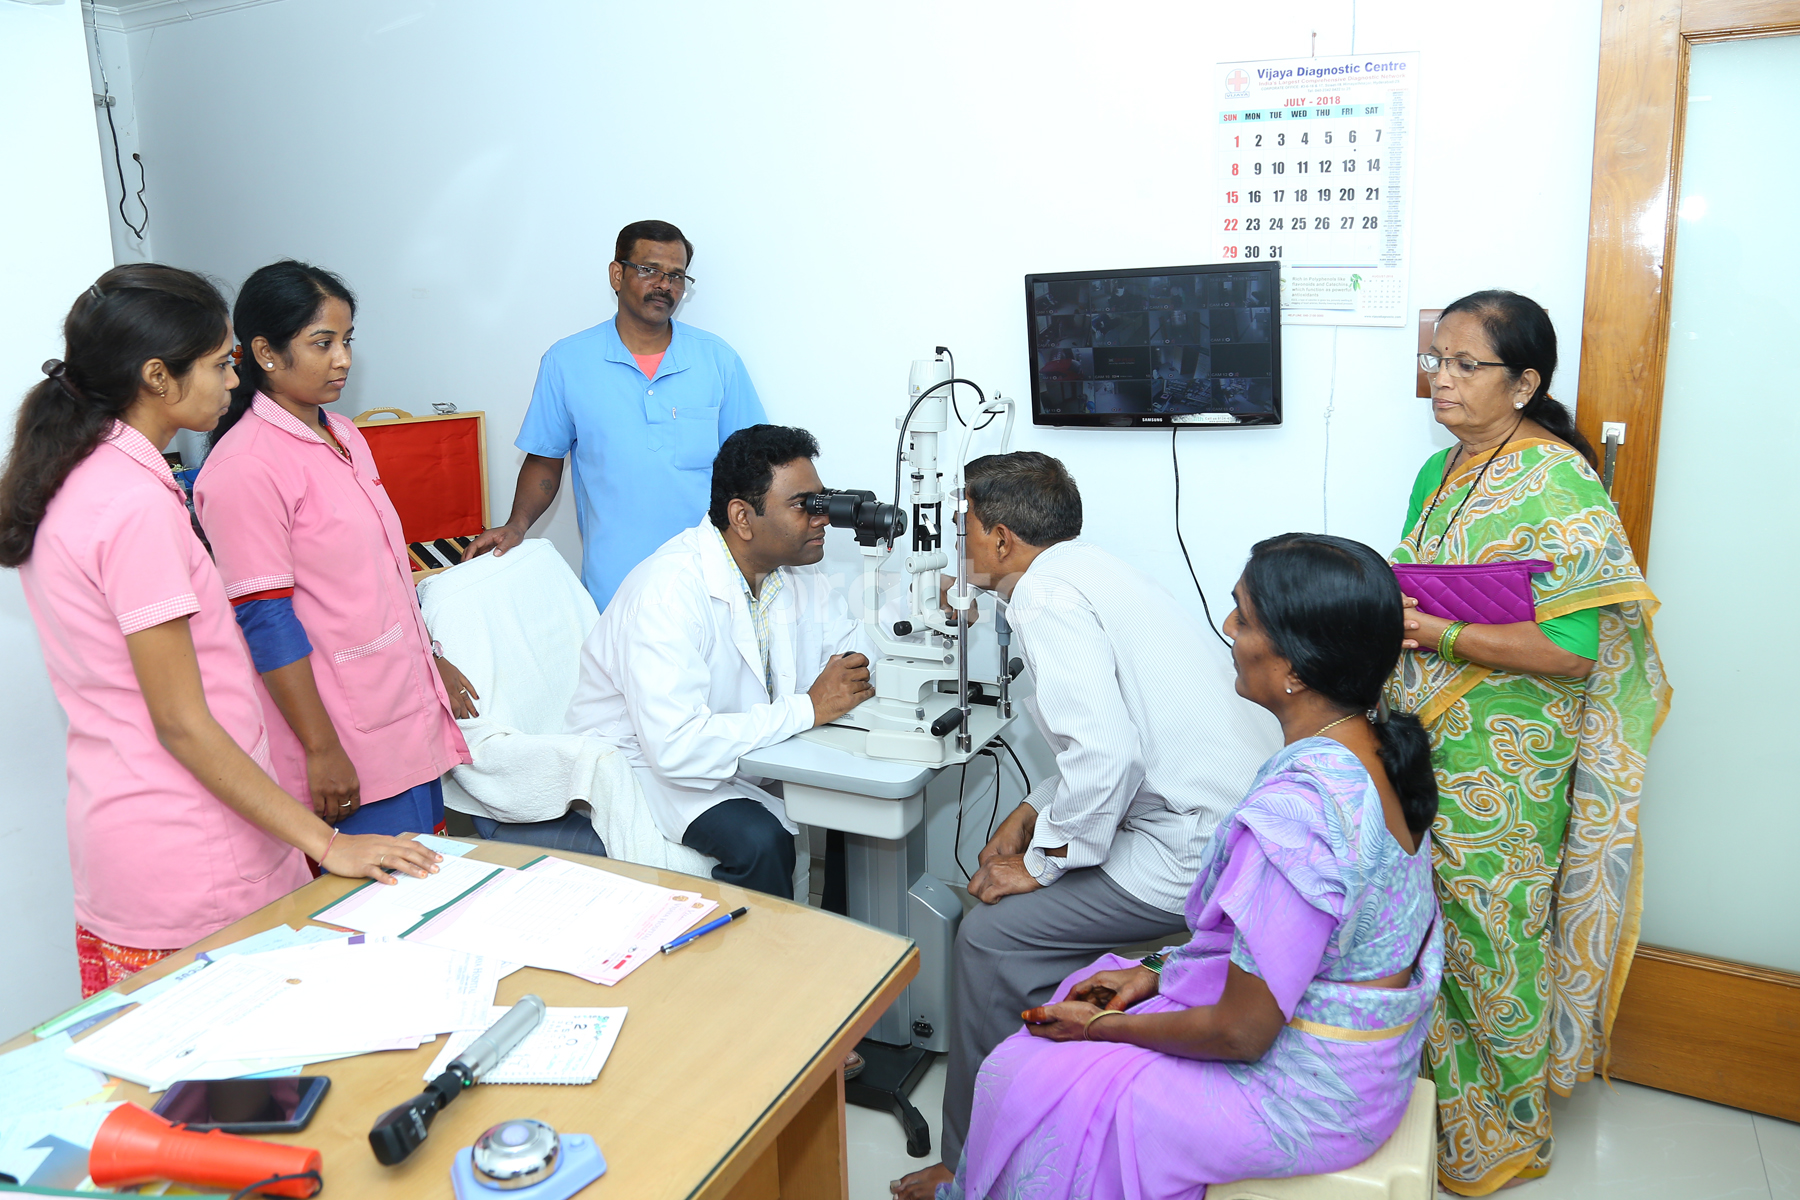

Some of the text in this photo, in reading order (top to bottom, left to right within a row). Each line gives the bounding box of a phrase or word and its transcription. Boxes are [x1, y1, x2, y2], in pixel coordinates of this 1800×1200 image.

[1257, 61, 1406, 81] Vijaya Diagnostic Centre
[1284, 97, 1306, 107] JULY
[1317, 96, 1341, 105] 2018
[1223, 114, 1238, 122] SUN
[1245, 112, 1261, 120] MON
[1270, 111, 1282, 119] TUE
[1291, 110, 1307, 118] WED
[1316, 109, 1330, 117] THU
[1365, 106, 1379, 115] SAT
[1235, 129, 1381, 147] 1 2 3 4 5 6 7
[1232, 159, 1380, 176] 8 9 10 11 12 13 14
[1226, 188, 1379, 203] 15 16 17 18 19 20 21
[1224, 216, 1378, 231] 22 23 24 25 26 27 28
[1223, 246, 1282, 258] 29 30 31
